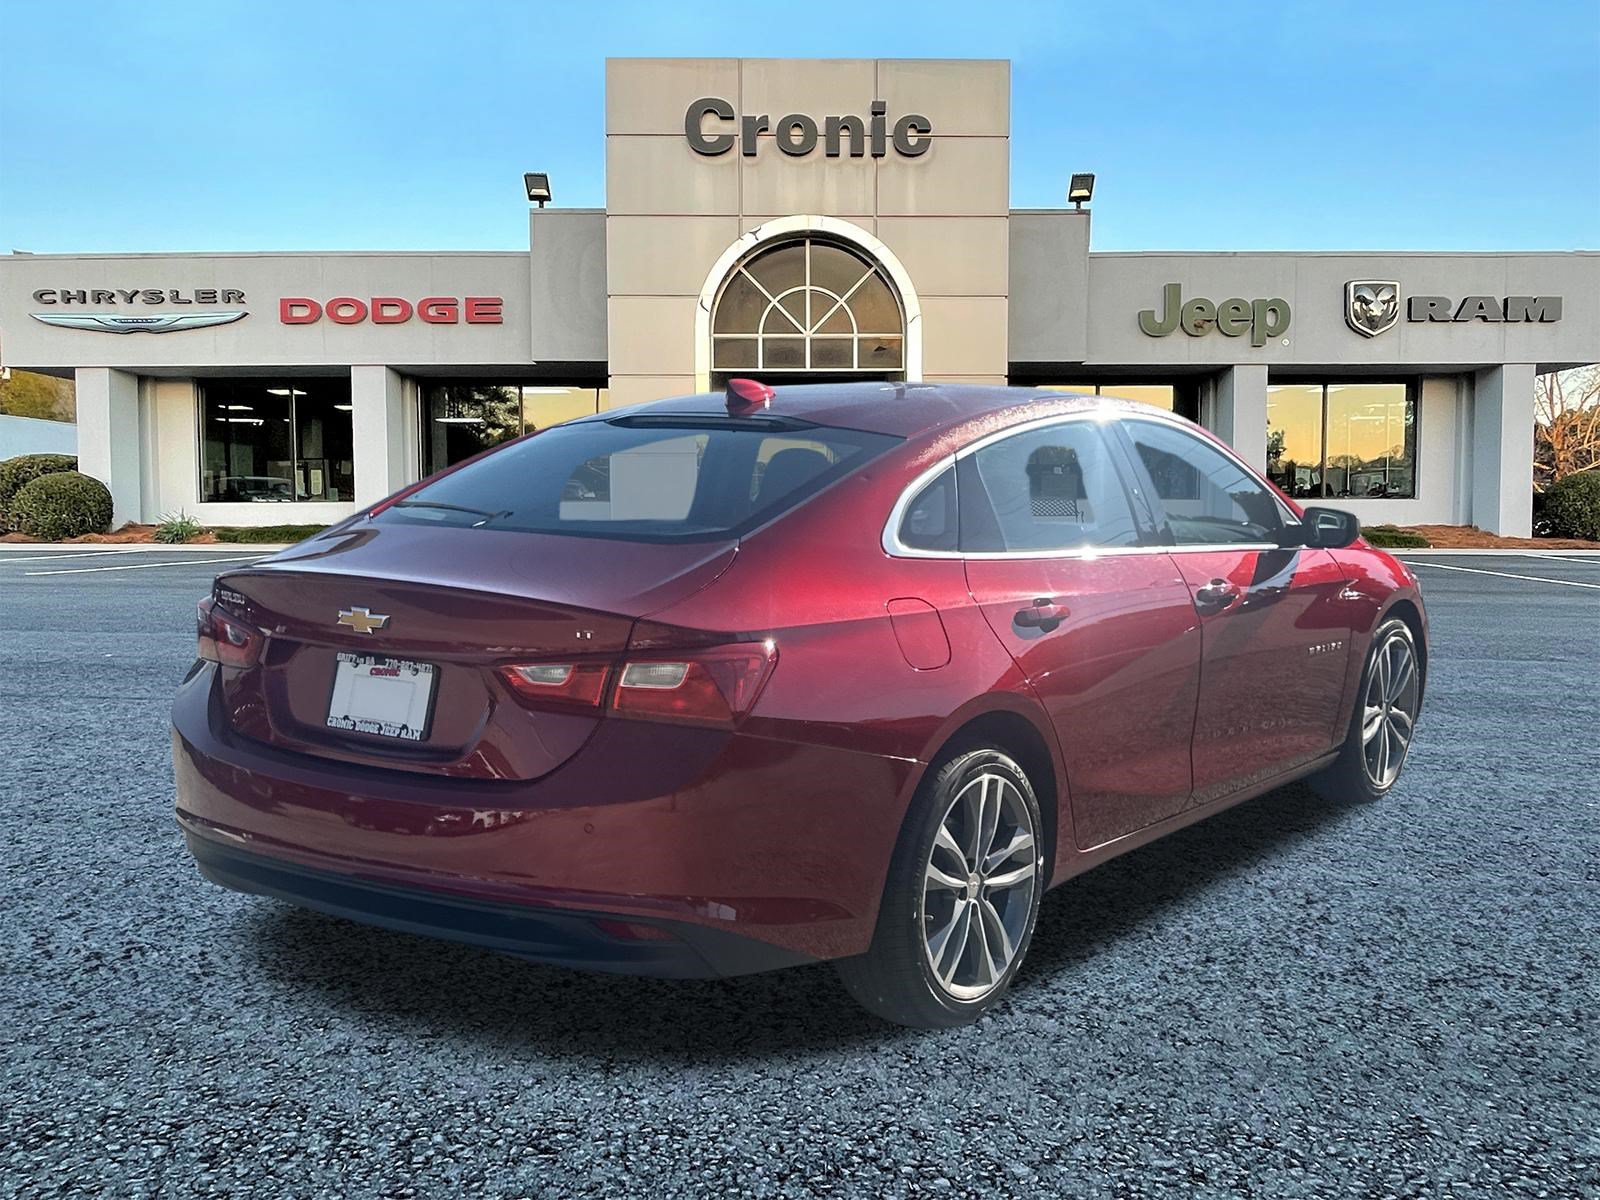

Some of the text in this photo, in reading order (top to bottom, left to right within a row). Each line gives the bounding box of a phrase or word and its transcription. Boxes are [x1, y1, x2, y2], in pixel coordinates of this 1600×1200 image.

[685, 97, 932, 158] Cronic
[32, 289, 246, 305] CHRYSLER
[1407, 296, 1563, 323] RAM
[280, 297, 503, 325] DODGE
[1138, 283, 1291, 346] Jeep
[327, 717, 421, 741] CRONIC DODGE JEEP RAM
